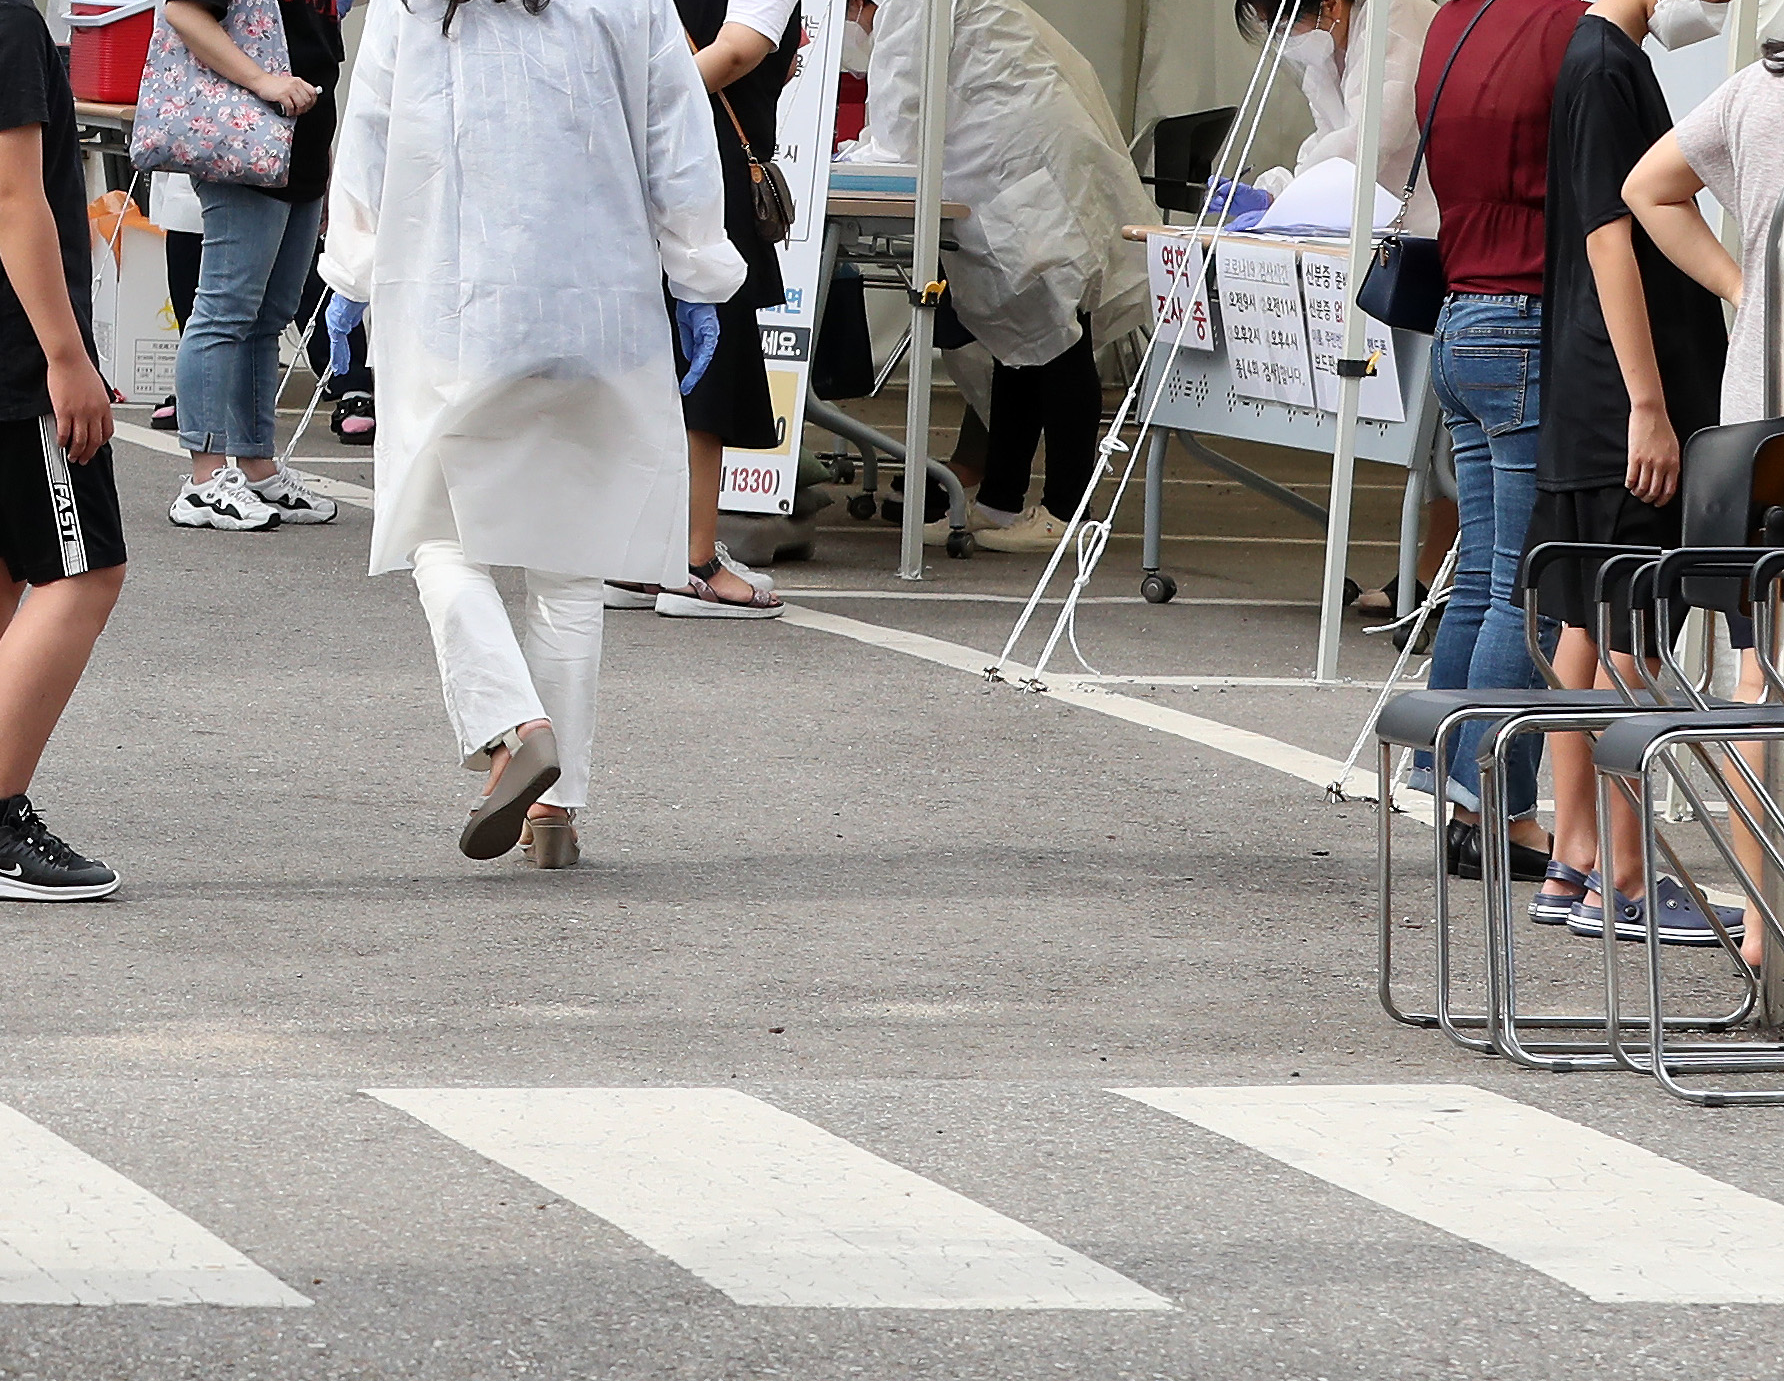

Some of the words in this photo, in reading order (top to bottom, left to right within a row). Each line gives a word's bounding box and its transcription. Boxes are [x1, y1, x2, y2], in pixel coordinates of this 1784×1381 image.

[1162, 245, 1190, 288] 역학
[1305, 262, 1331, 290] 신분증
[1192, 301, 1207, 341] 중
[1309, 299, 1331, 321] 신분증
[761, 330, 801, 357] 세요.
[53, 483, 79, 542] FAST
